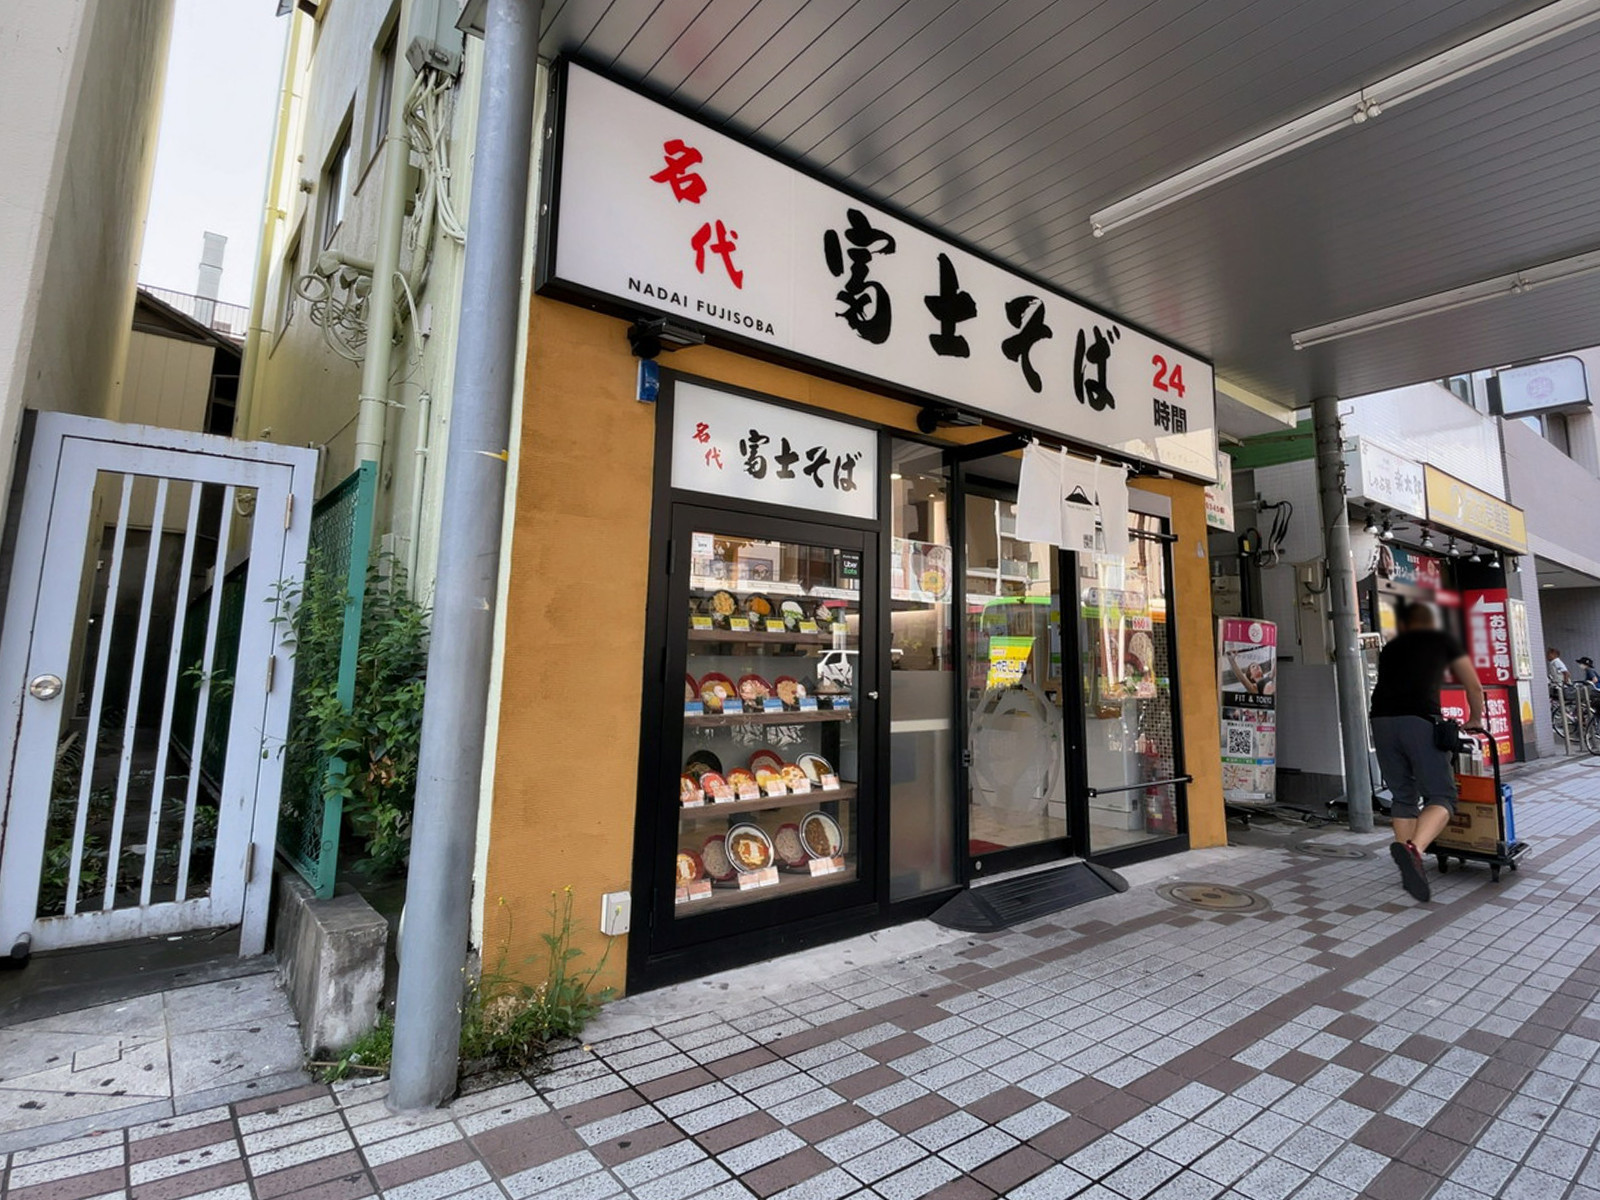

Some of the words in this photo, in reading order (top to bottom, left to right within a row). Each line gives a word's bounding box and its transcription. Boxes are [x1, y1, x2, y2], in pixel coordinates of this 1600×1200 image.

[650, 138, 744, 290] 名代
[628, 277, 688, 309] NADAI
[697, 299, 776, 337] FUJISOBA
[824, 207, 1121, 412] 富士そば
[1151, 354, 1186, 398] 24
[1153, 397, 1187, 435] 時間
[692, 421, 724, 470] 名代
[738, 428, 863, 492] 富士そば
[843, 560, 857, 568] Uber
[1489, 614, 1510, 682] お持ち帰り
[1234, 694, 1245, 702] FIT
